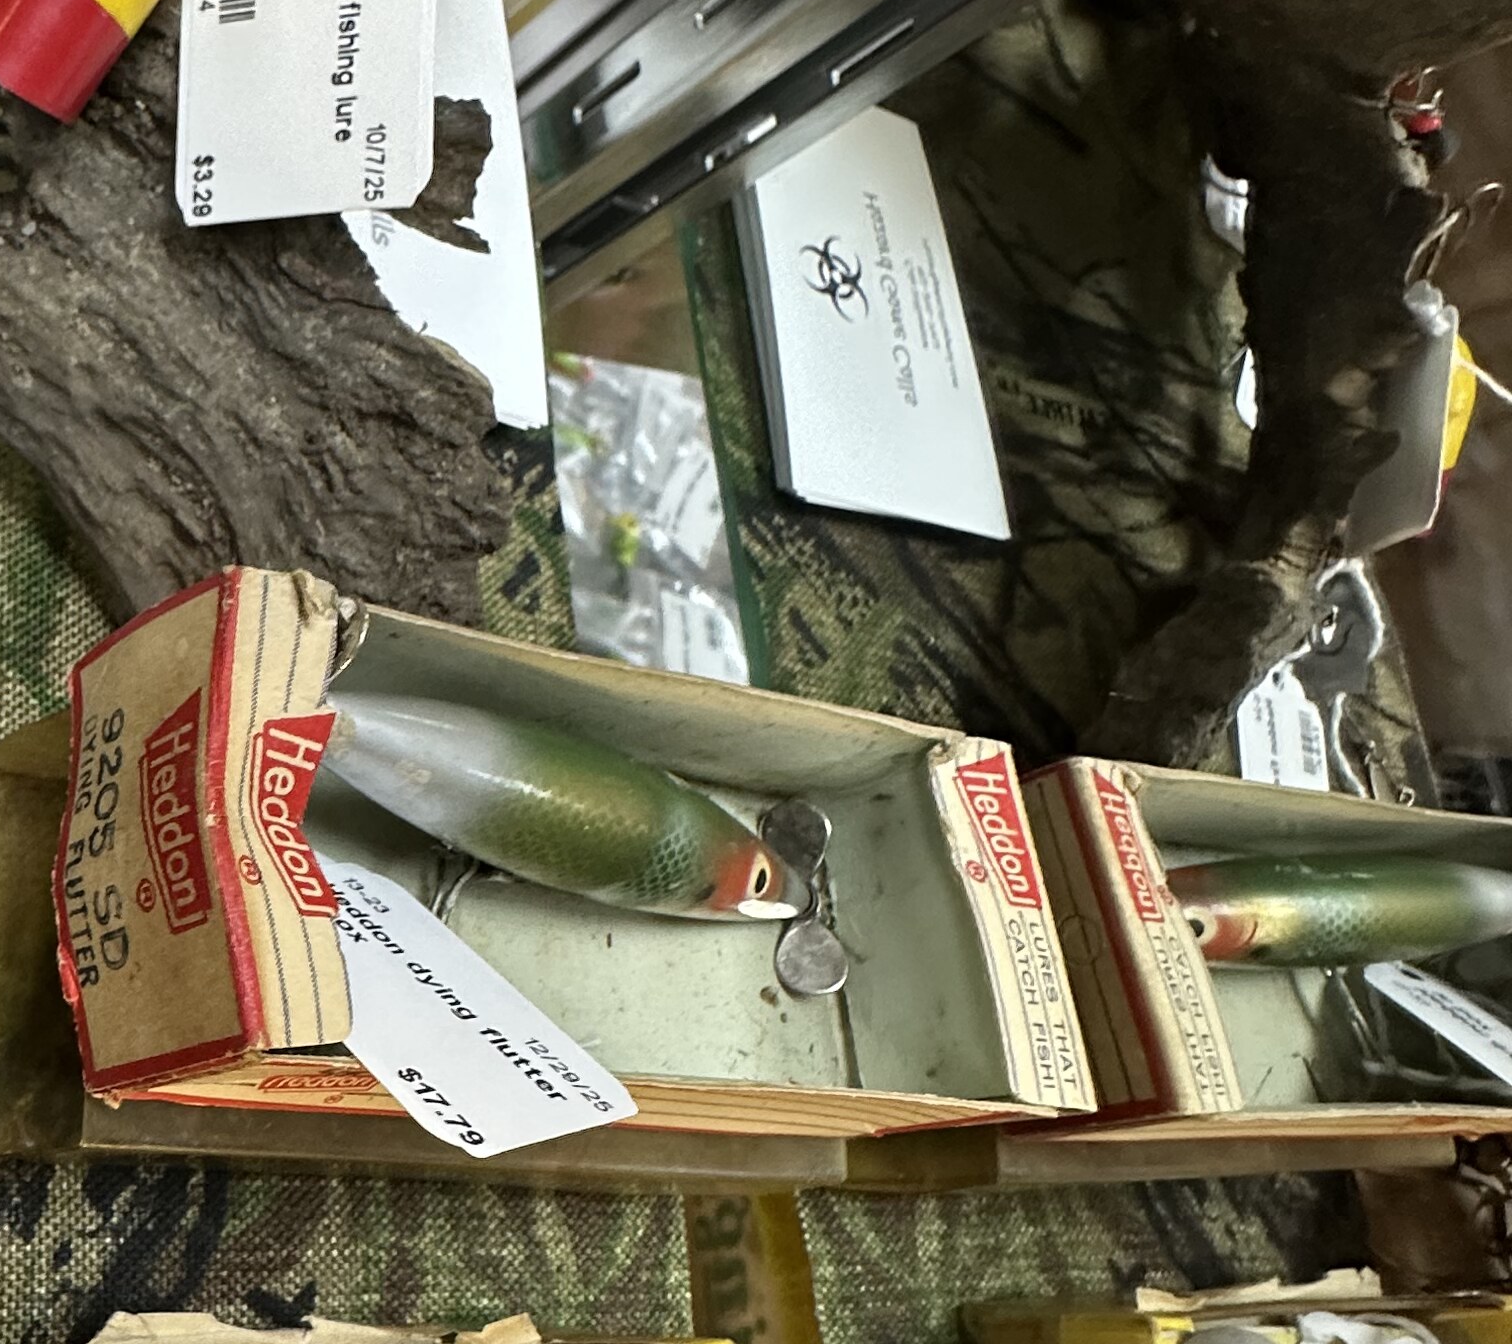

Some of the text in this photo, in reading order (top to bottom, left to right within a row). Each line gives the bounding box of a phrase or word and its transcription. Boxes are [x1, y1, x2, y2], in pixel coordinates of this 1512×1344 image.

[331, 3, 361, 85] fishing
[335, 97, 358, 143] lure
[364, 123, 387, 201] 10/7/25
[192, 156, 215, 217] $3.29
[89, 708, 129, 971] 9205 SD
[149, 721, 201, 910] Heddon
[262, 727, 324, 901] Heddon
[962, 770, 1030, 894] Heddon
[64, 841, 100, 988] FLUTTER
[335, 918, 369, 943] ox
[342, 877, 390, 913] 13-23
[1008, 917, 1040, 1006] CATCH
[1029, 921, 1078, 1088] LURES THAT
[406, 960, 477, 1022] dying
[479, 1027, 567, 1102] flutter
[397, 1067, 484, 1147] $17.79
